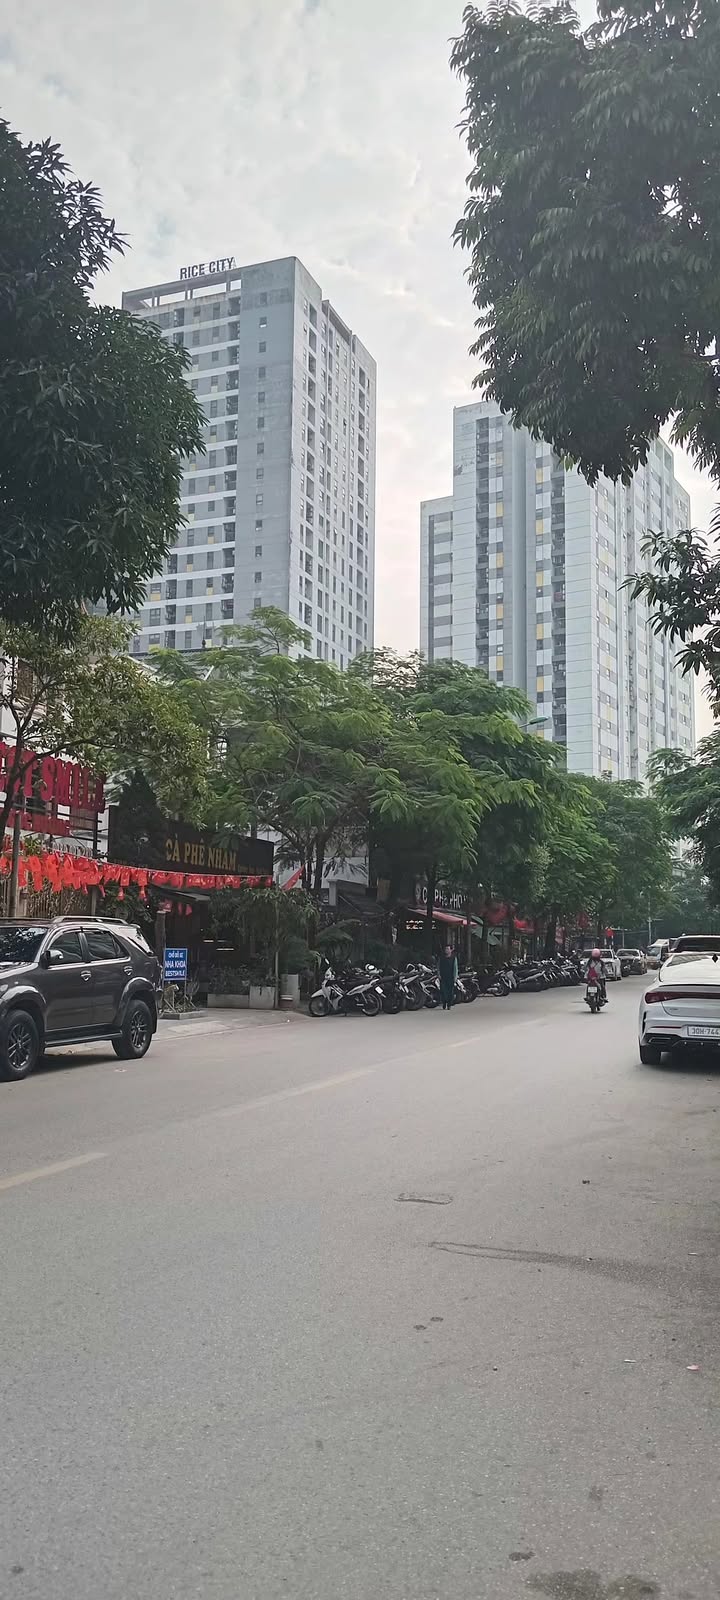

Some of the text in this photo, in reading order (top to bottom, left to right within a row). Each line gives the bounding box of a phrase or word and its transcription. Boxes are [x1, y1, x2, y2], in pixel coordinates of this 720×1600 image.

[180, 256, 234, 280] RICE CITY
[184, 838, 205, 866] PHÊ
